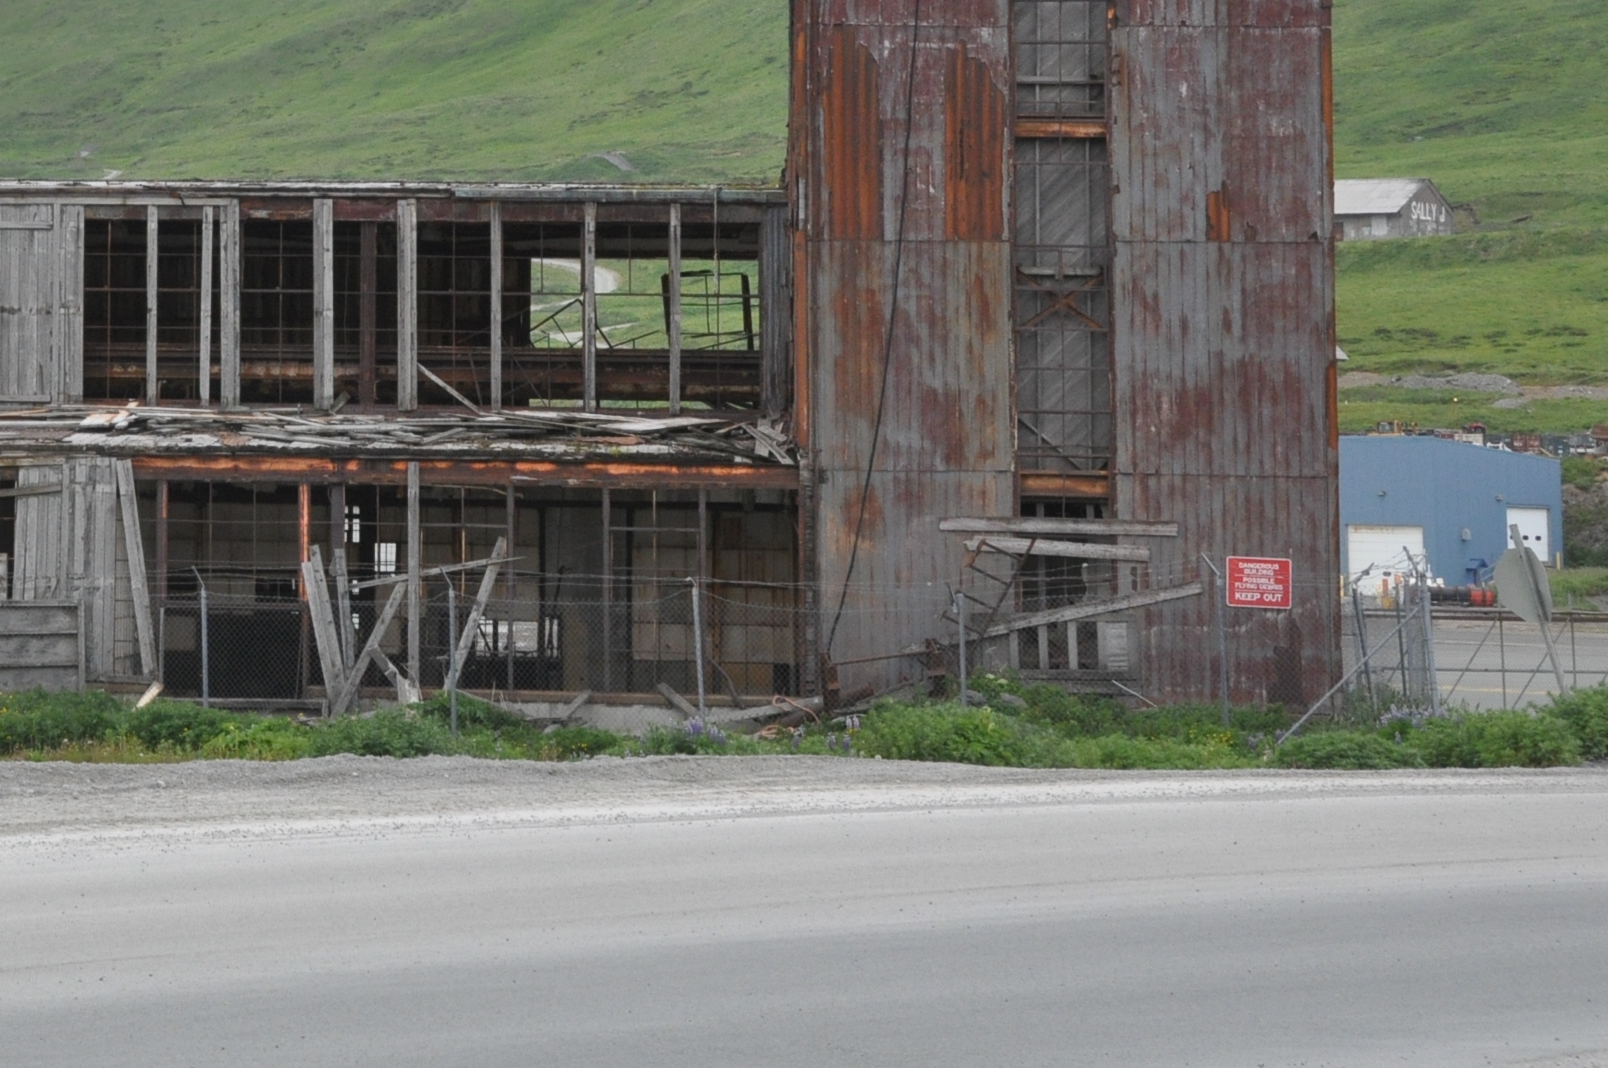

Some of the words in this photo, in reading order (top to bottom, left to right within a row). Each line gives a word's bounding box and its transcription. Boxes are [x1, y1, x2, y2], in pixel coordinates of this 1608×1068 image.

[1411, 201, 1437, 221] SALLY
[1439, 206, 1445, 222] J
[1238, 562, 1279, 570] DANGEROUS
[1235, 592, 1261, 601] KEEP
[1263, 593, 1283, 602] OUT
